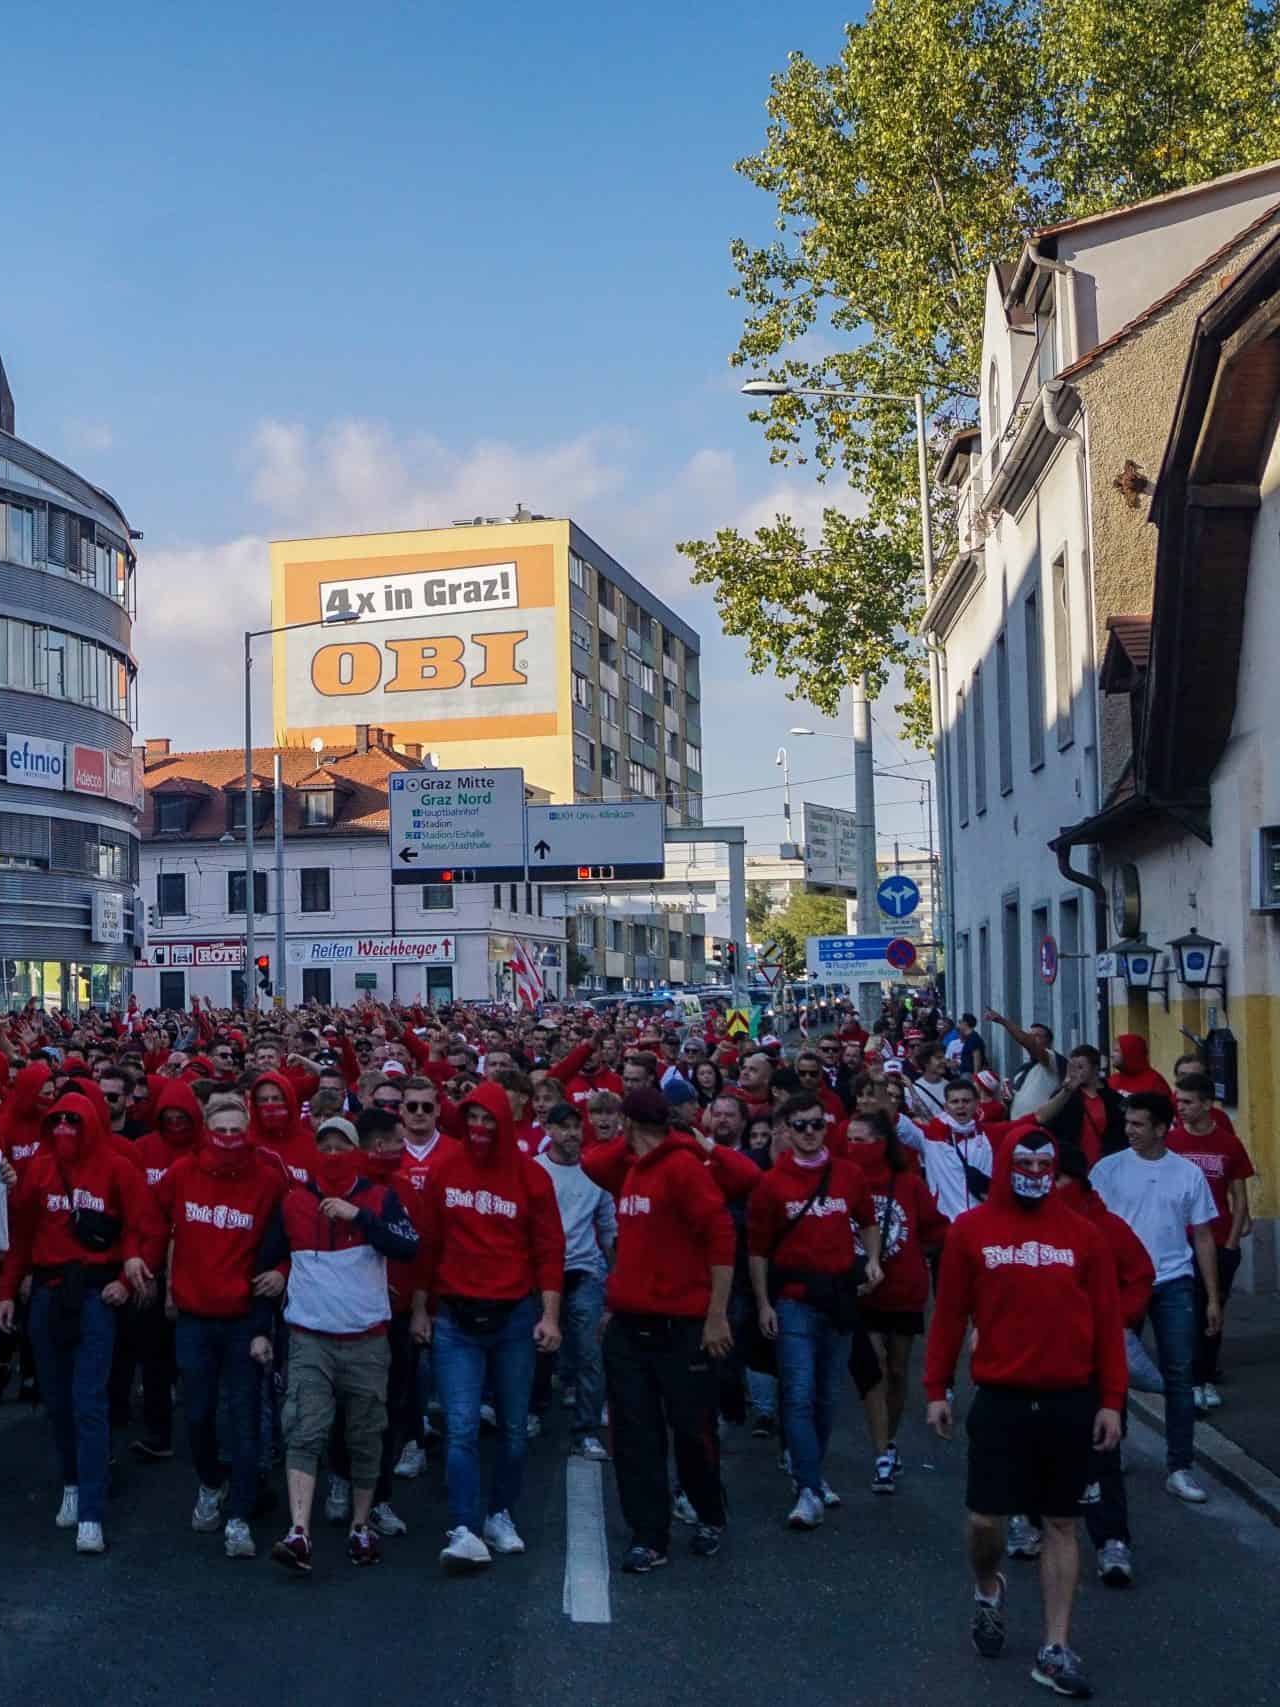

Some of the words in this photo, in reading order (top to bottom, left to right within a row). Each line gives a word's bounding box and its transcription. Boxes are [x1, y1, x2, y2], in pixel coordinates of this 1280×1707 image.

[325, 587, 375, 614] 4x
[384, 584, 413, 612] in
[423, 571, 512, 607] Graz!
[311, 630, 529, 697] OBI
[421, 778, 452, 790] Graz
[458, 775, 496, 789] Mitte
[421, 794, 452, 806] Graz
[458, 791, 492, 805] Nord
[422, 820, 453, 829] Stadion
[311, 943, 353, 959] Reifen
[357, 938, 438, 959] Weichberger
